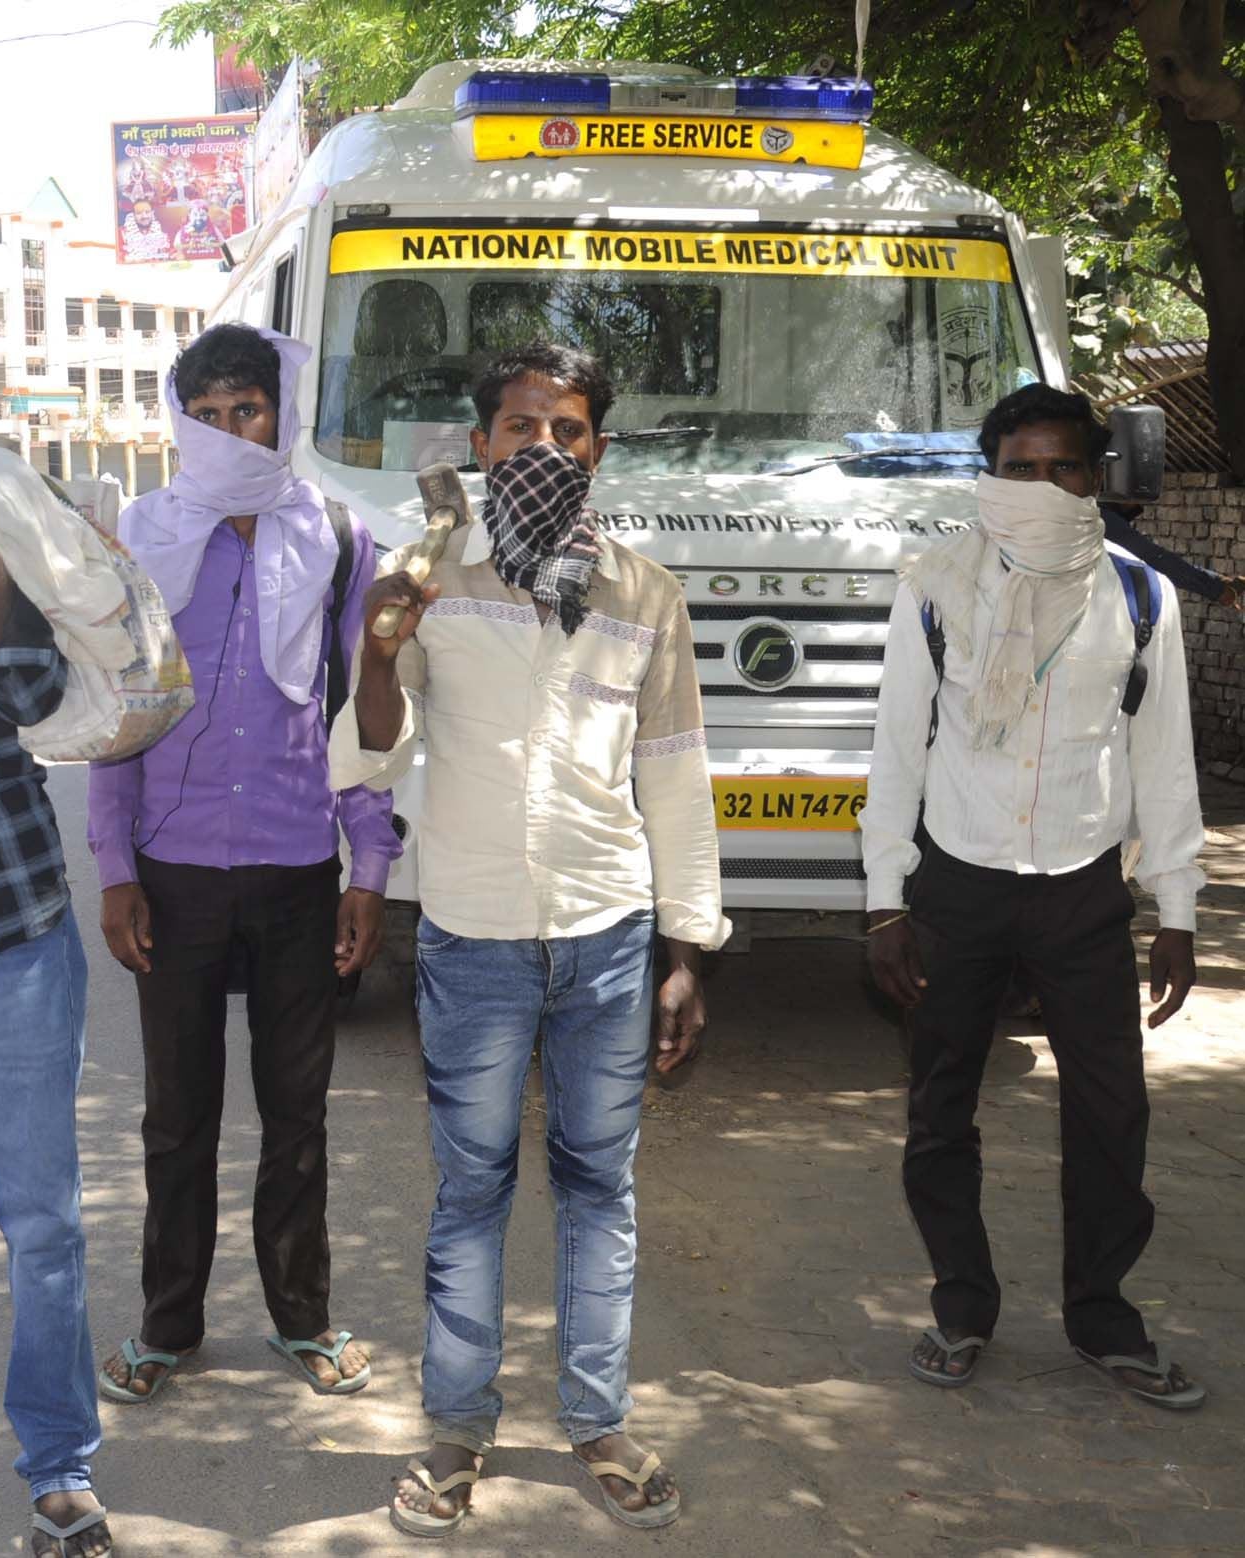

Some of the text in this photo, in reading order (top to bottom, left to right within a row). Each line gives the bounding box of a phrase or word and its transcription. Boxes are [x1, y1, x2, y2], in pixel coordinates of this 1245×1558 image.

[586, 123, 645, 147] FREE
[653, 124, 753, 148] SERVICE
[402, 235, 957, 271] NATIONAL MOBILE MEDICAL UNIT
[595, 514, 647, 532] NED
[657, 514, 803, 533] INITIATIVE
[811, 518, 844, 534] OF
[906, 519, 929, 536] &
[723, 793, 867, 818] 32 LN 7476
